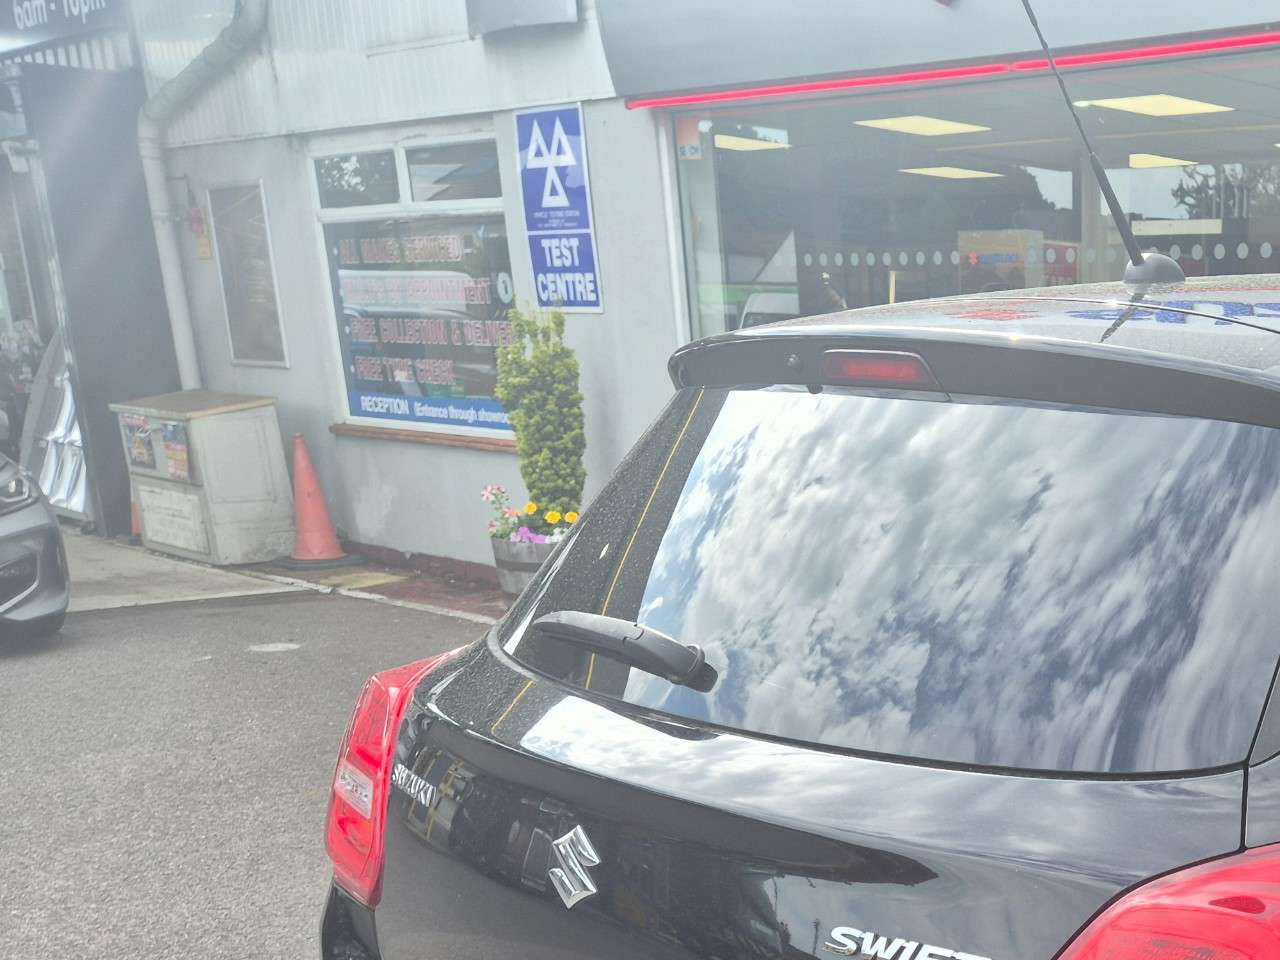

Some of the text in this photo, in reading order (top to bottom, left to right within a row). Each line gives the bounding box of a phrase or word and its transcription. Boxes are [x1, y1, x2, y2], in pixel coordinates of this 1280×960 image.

[541, 238, 580, 267] TEST
[537, 272, 597, 301] CENTRE
[350, 318, 378, 343] FREE
[380, 319, 448, 345] COLLECTION
[464, 320, 512, 347] DELIVER
[355, 356, 384, 381] FREE
[361, 396, 410, 415] RECEPTION
[448, 405, 477, 423] through
